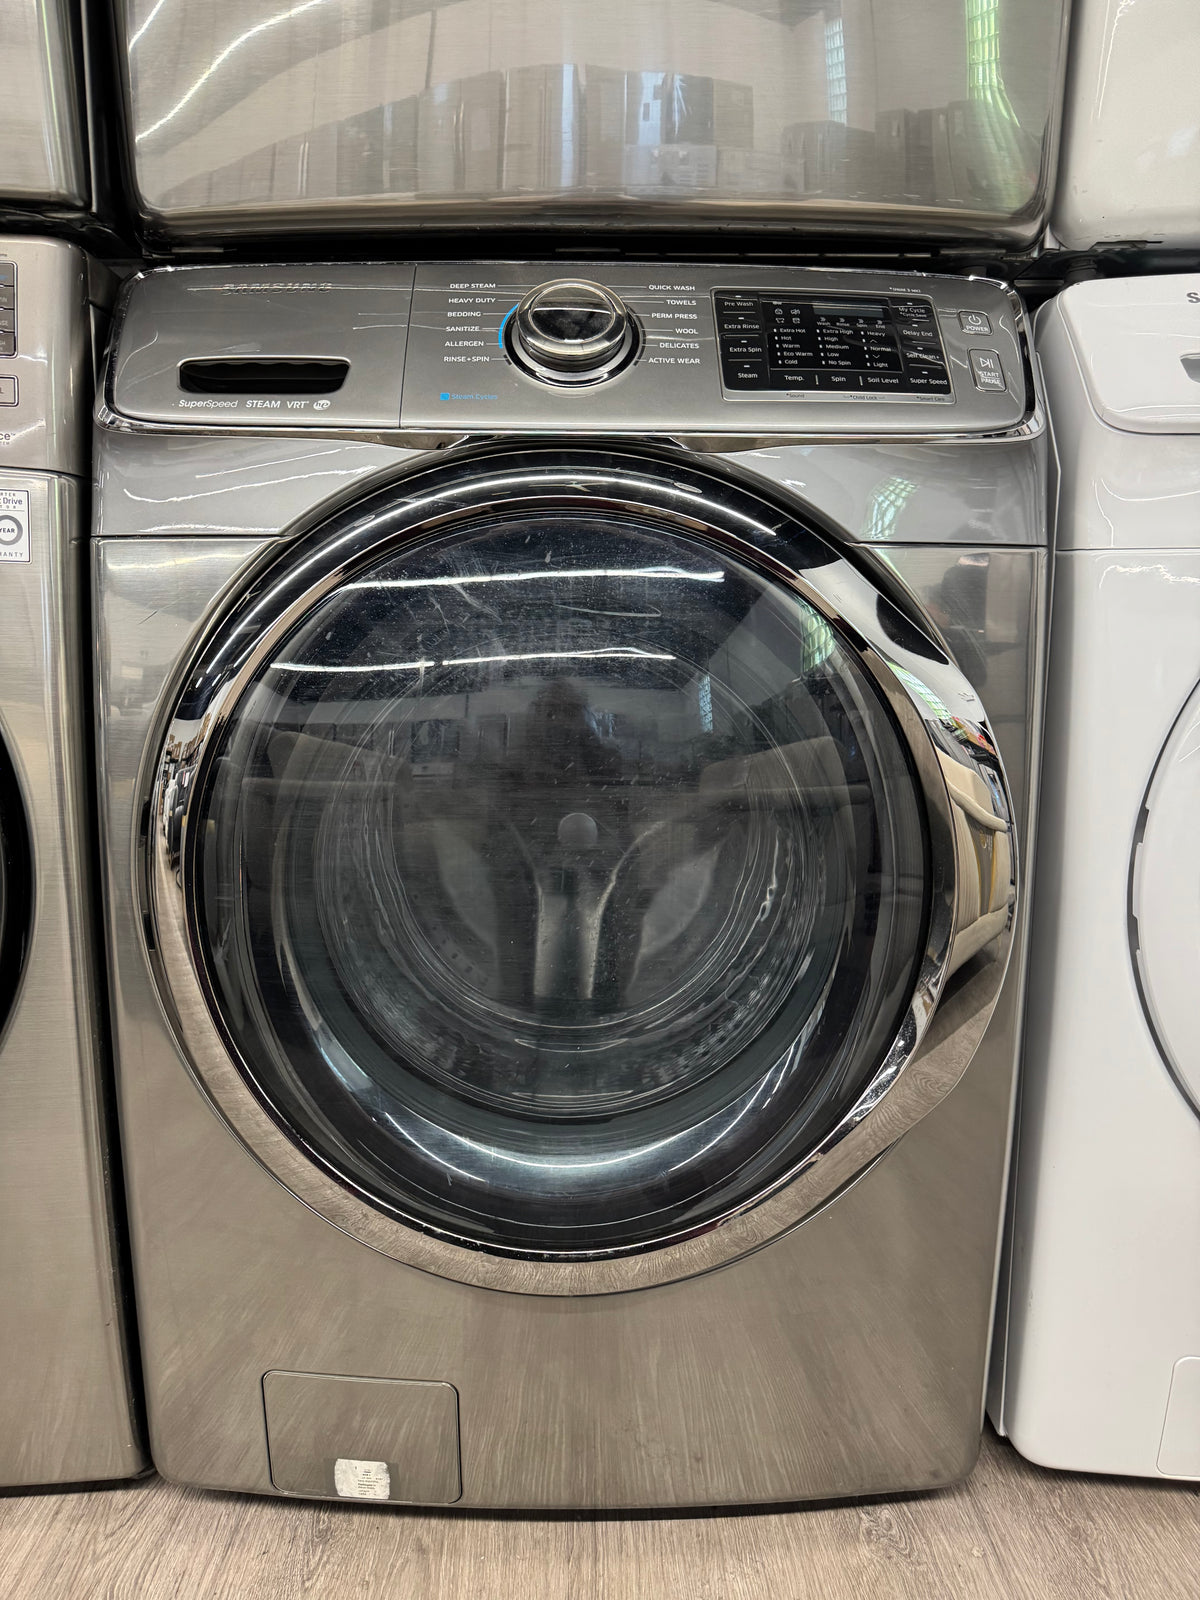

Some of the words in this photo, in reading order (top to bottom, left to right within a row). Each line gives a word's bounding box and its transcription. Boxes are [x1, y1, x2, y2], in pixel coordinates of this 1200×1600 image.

[220, 283, 333, 295] SAMSUNG
[909, 377, 928, 385] Super
[178, 399, 239, 409] SuperSpeed
[245, 400, 281, 408] STEAM
[2, 497, 23, 505] Drive
